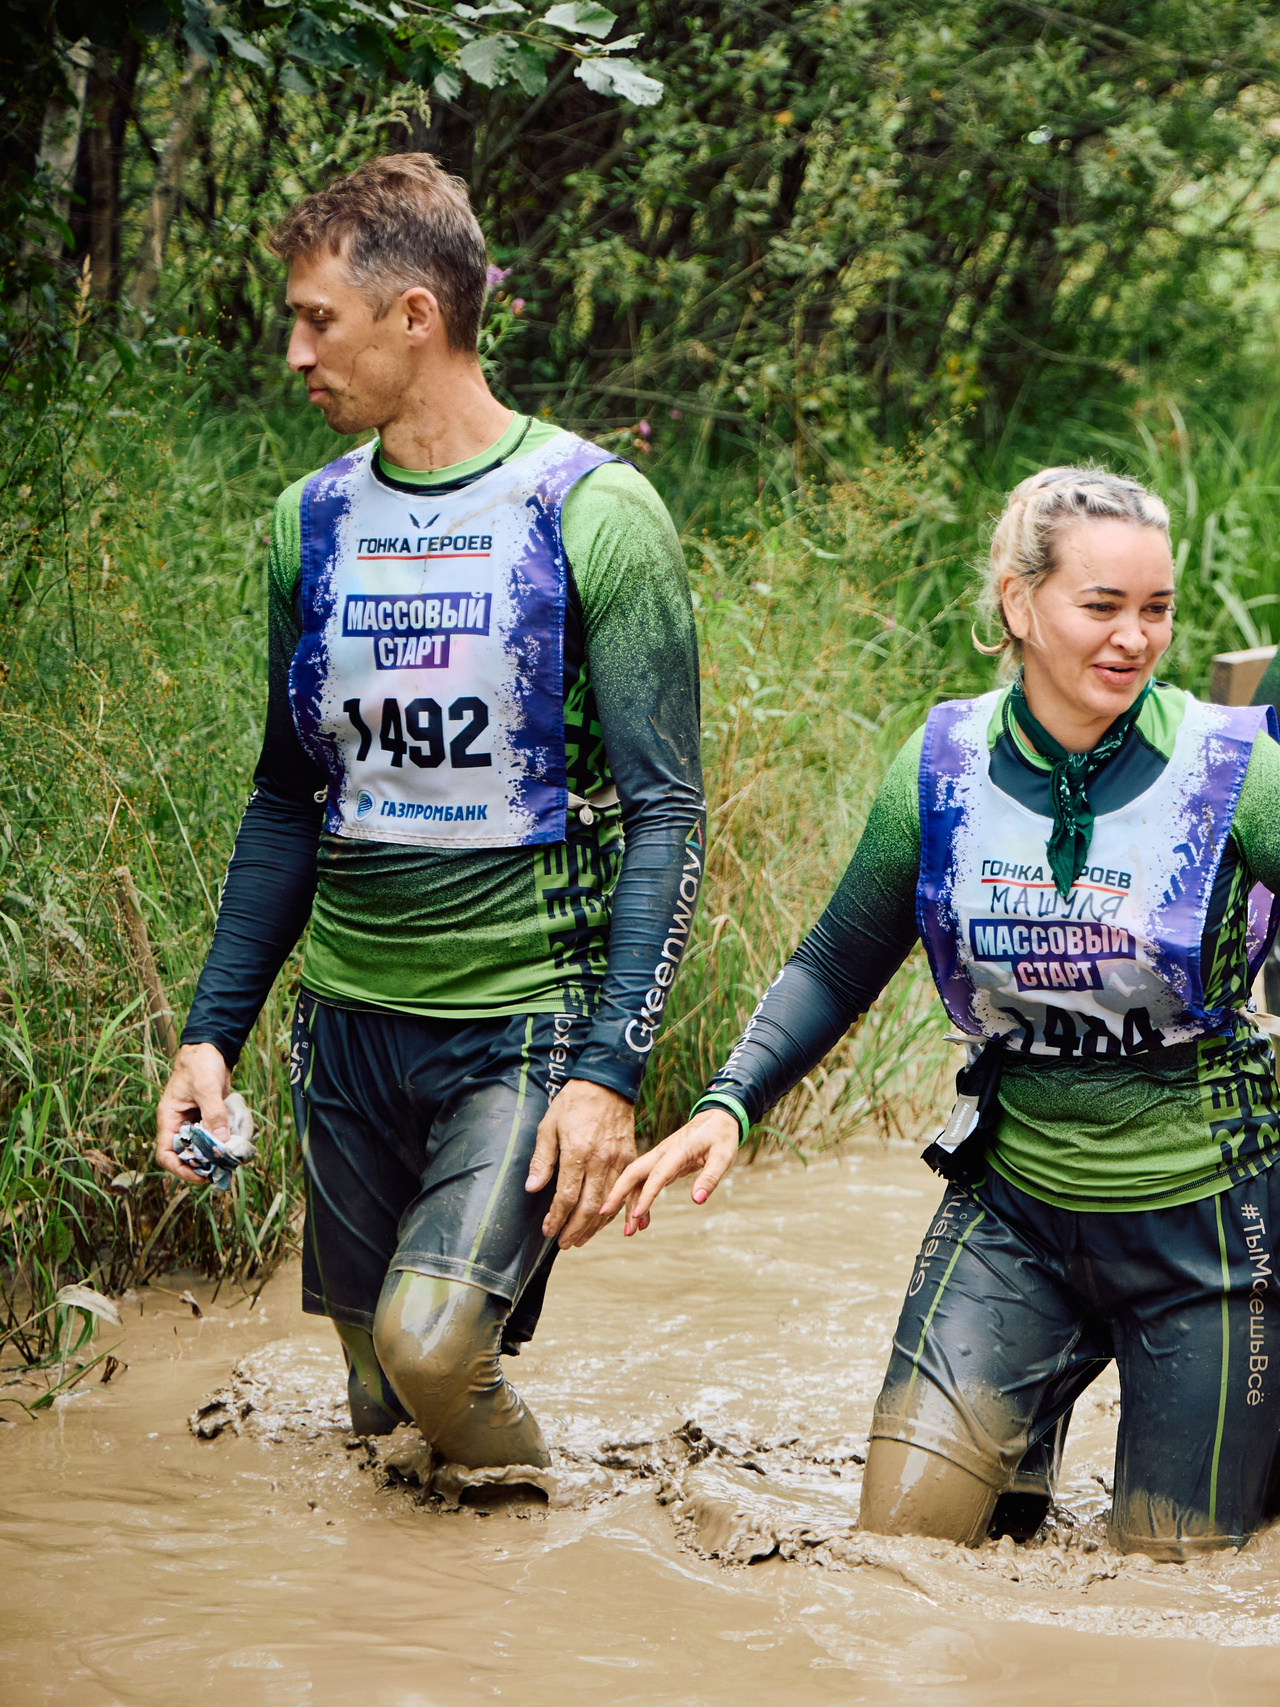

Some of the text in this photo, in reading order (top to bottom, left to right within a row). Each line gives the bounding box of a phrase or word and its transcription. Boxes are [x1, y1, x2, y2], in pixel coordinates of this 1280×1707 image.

[357, 534, 493, 554] ГОНКА ГЕРОЕВ
[346, 592, 487, 631] МАССОВЫЙ
[378, 635, 446, 667] СТАРТ
[343, 696, 492, 769] 1492
[380, 801, 488, 821] ГАЗПРОМБАНК
[981, 860, 1132, 889] ГОНКА РОЕВ
[990, 885, 1125, 922] МАШУЛЯ
[624, 847, 703, 1053] Greenway
[974, 923, 1129, 956] МАССОВЫЙ
[1016, 961, 1095, 989] СТАРТ
